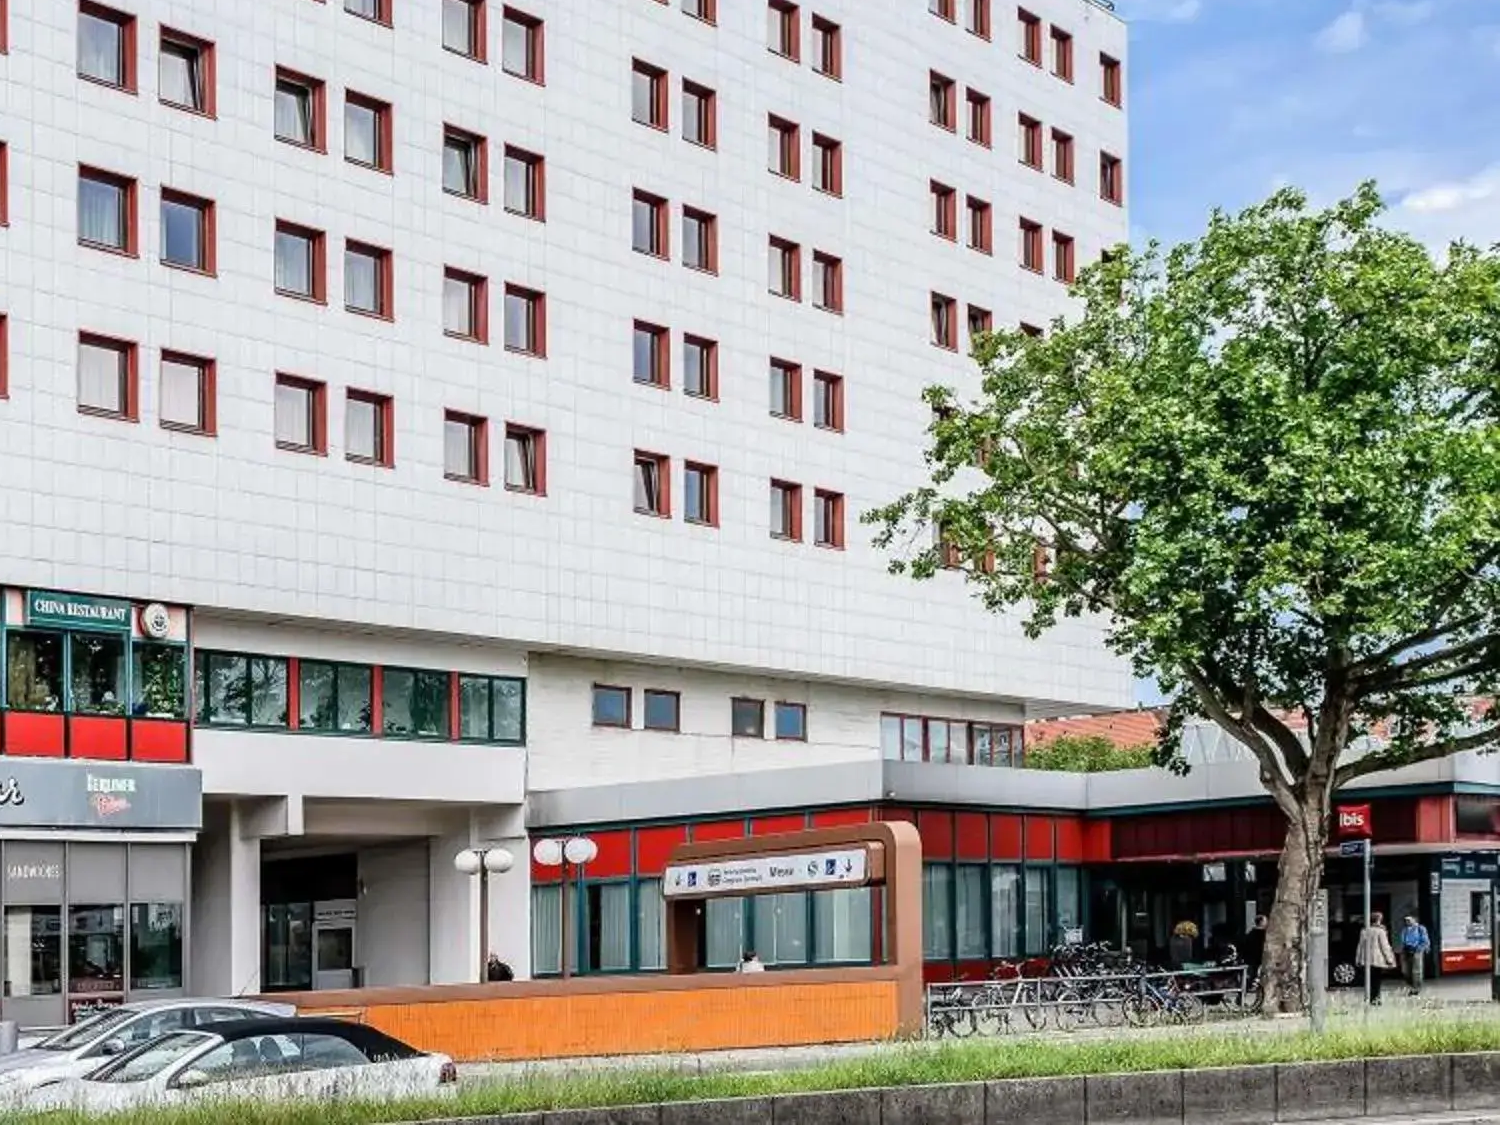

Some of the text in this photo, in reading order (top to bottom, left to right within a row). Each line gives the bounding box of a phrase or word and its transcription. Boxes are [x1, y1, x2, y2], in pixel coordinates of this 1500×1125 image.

[34, 598, 127, 621] CHINA RESTAURANT
[1339, 812, 1365, 827] ibis
